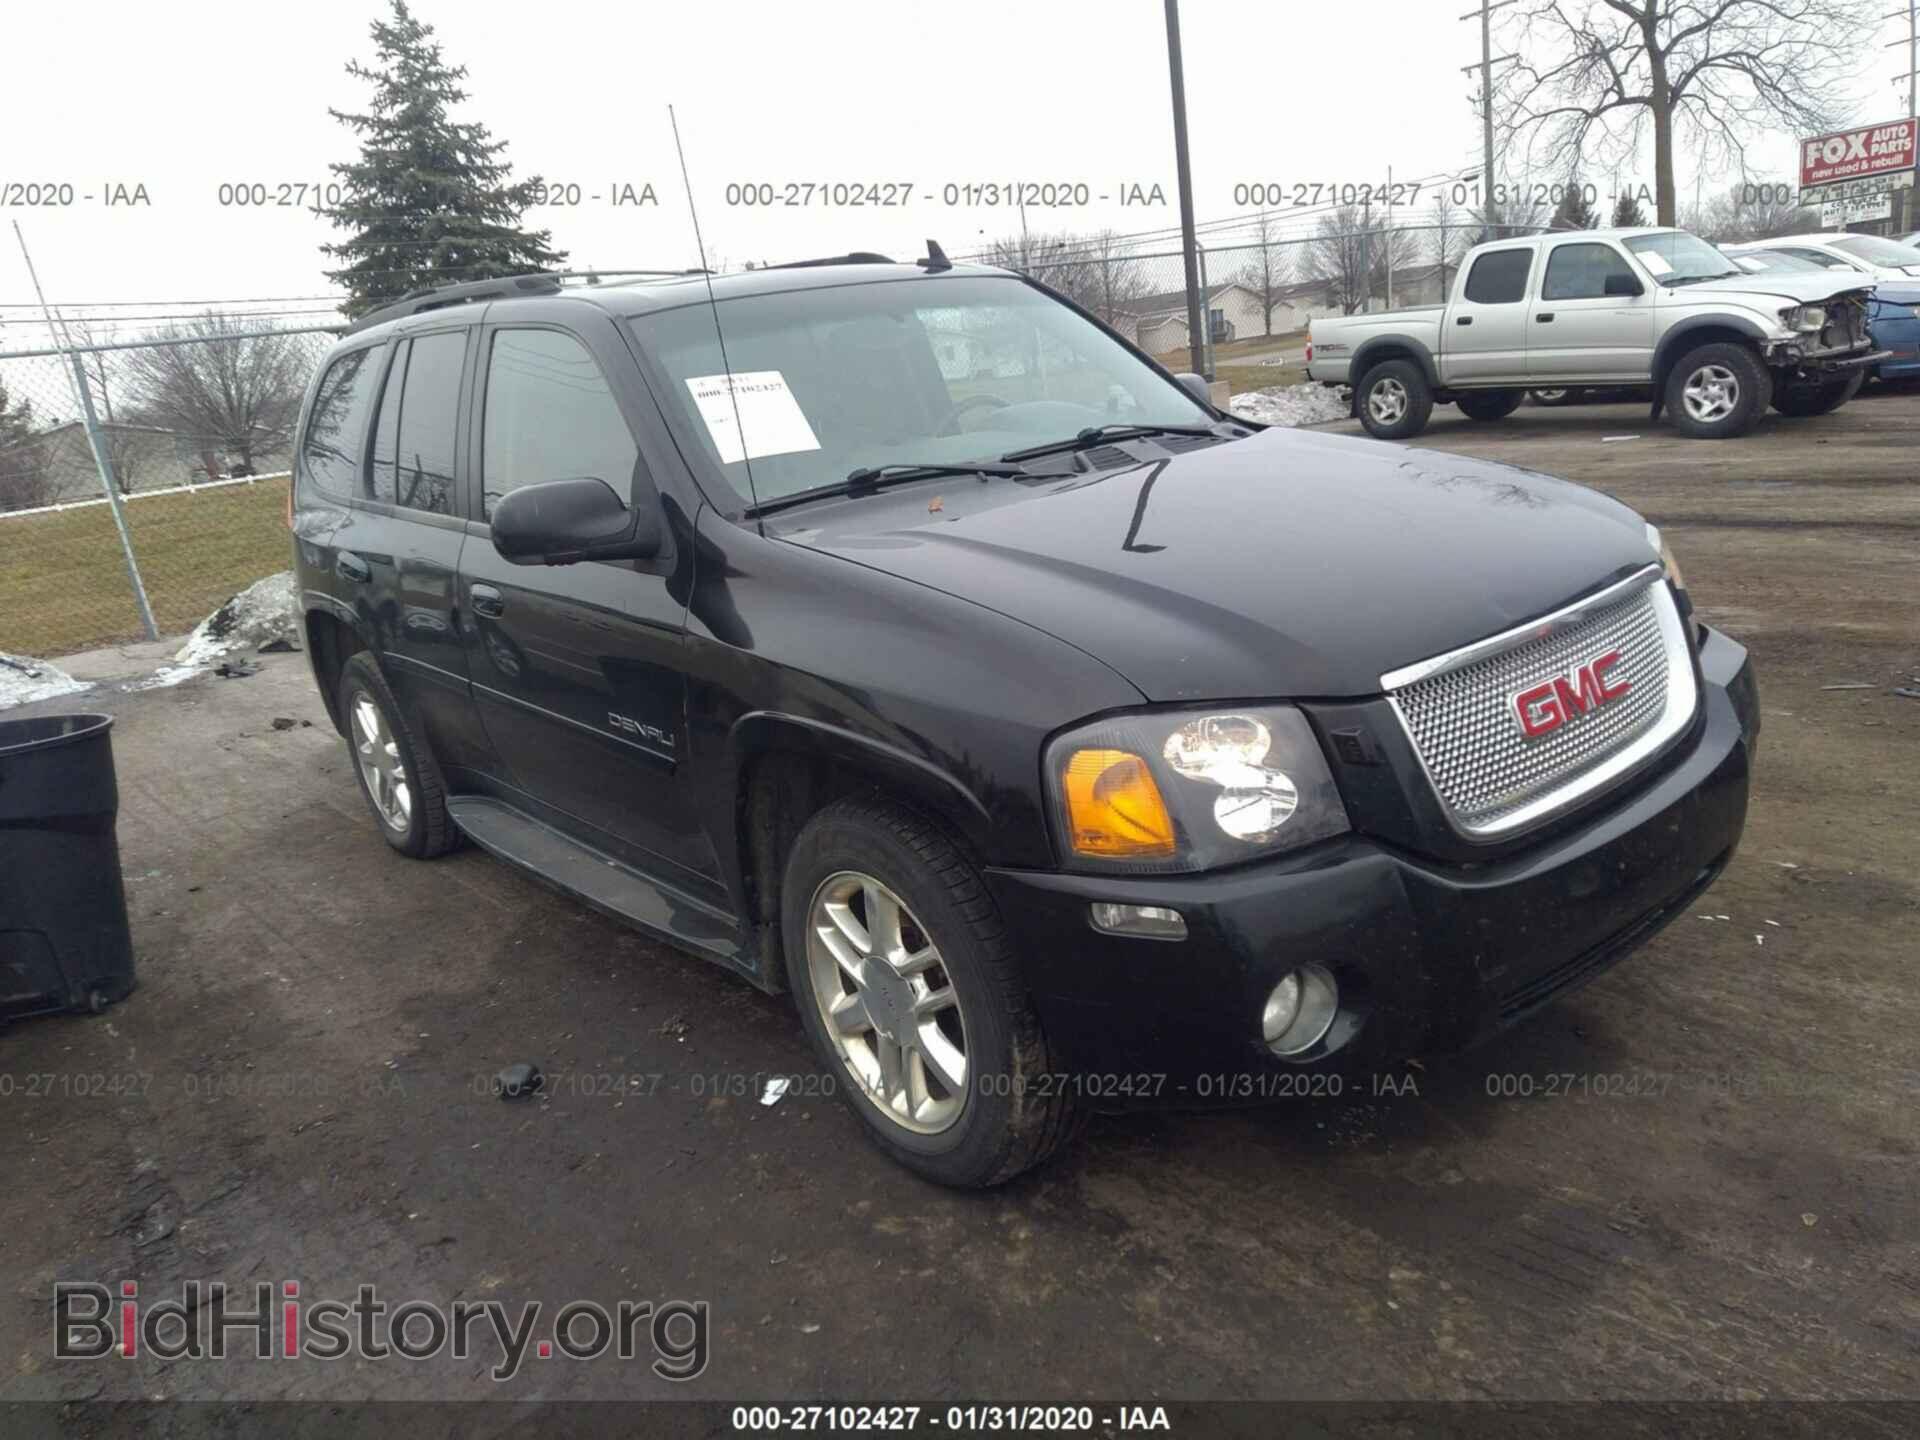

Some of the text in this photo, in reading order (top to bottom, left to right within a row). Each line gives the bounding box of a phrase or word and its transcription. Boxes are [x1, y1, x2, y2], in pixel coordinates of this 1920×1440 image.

[1870, 137, 1912, 156] PARTS
[1871, 124, 1909, 143] AUTO
[1806, 132, 1869, 168] FOX
[1812, 168, 1833, 178] new
[1834, 162, 1859, 177] used
[1507, 646, 1633, 738] GMC
[607, 711, 675, 748] DENALI
